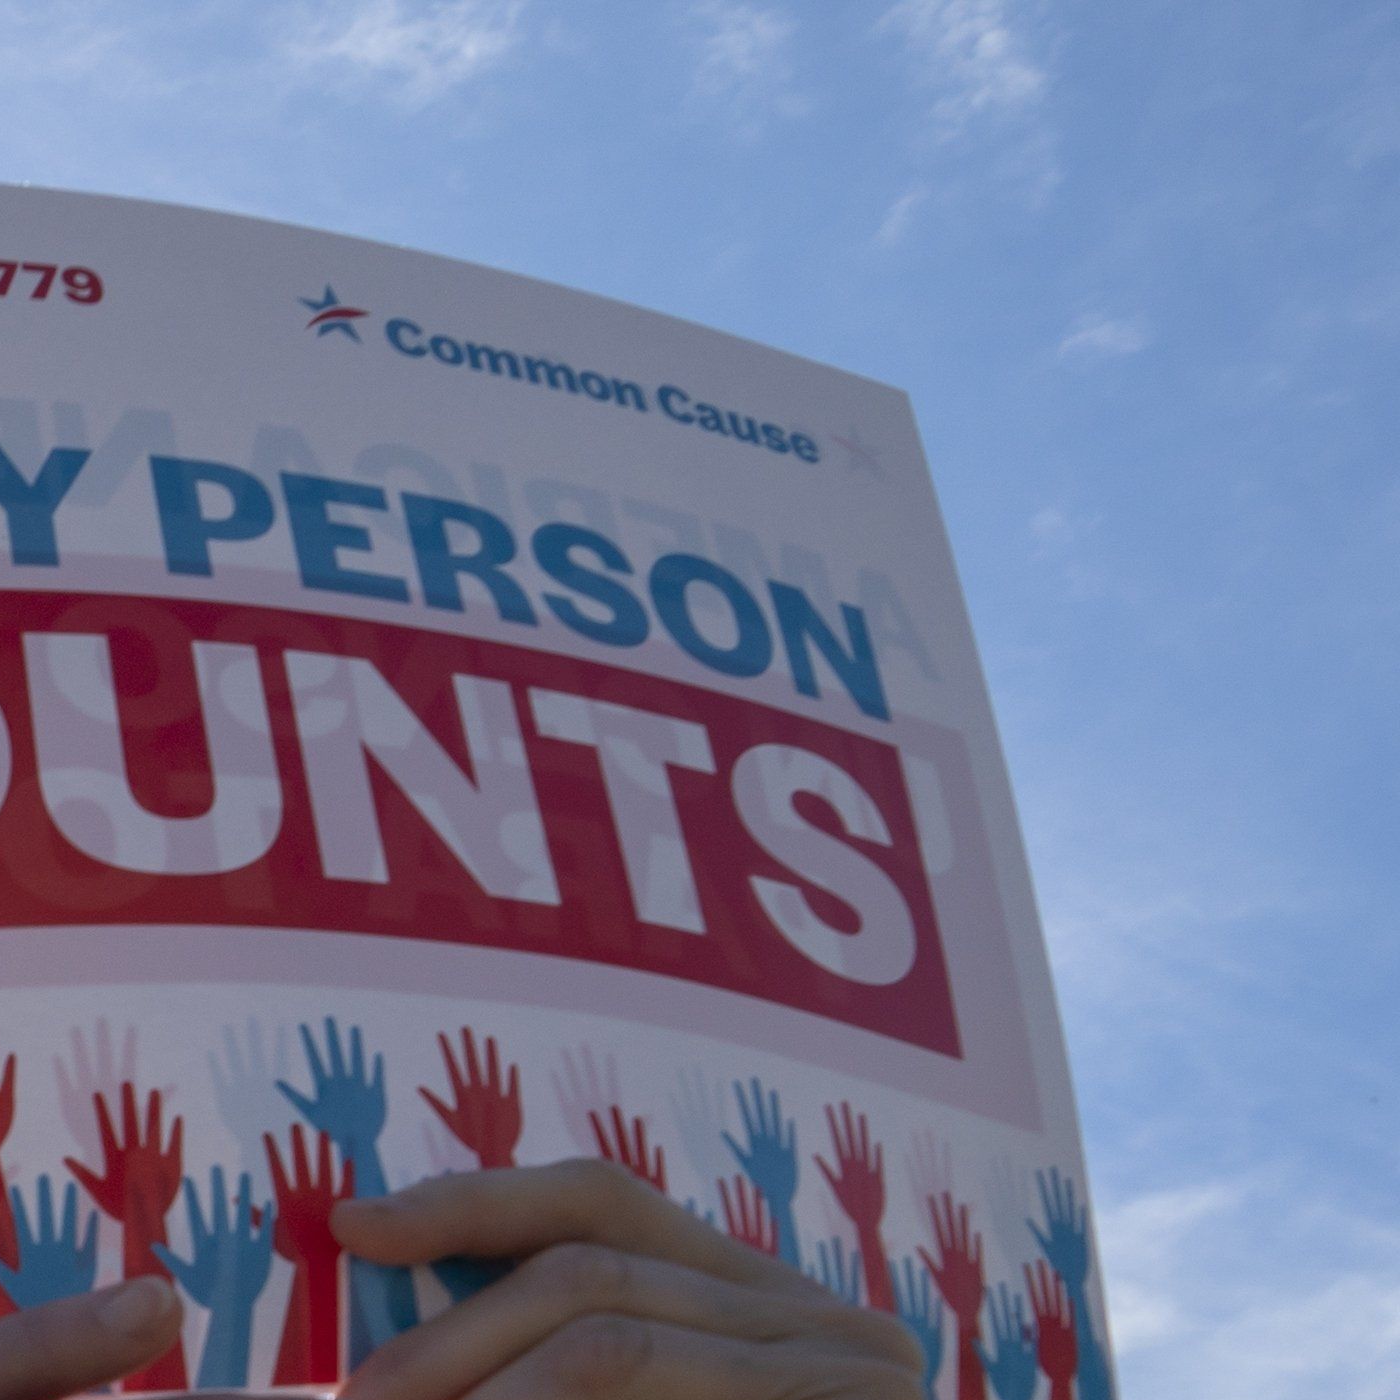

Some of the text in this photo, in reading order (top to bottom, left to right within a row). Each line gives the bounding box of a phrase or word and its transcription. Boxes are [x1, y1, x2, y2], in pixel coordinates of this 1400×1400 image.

[384, 316, 822, 465] Common Cause
[148, 453, 894, 724] PERSON
